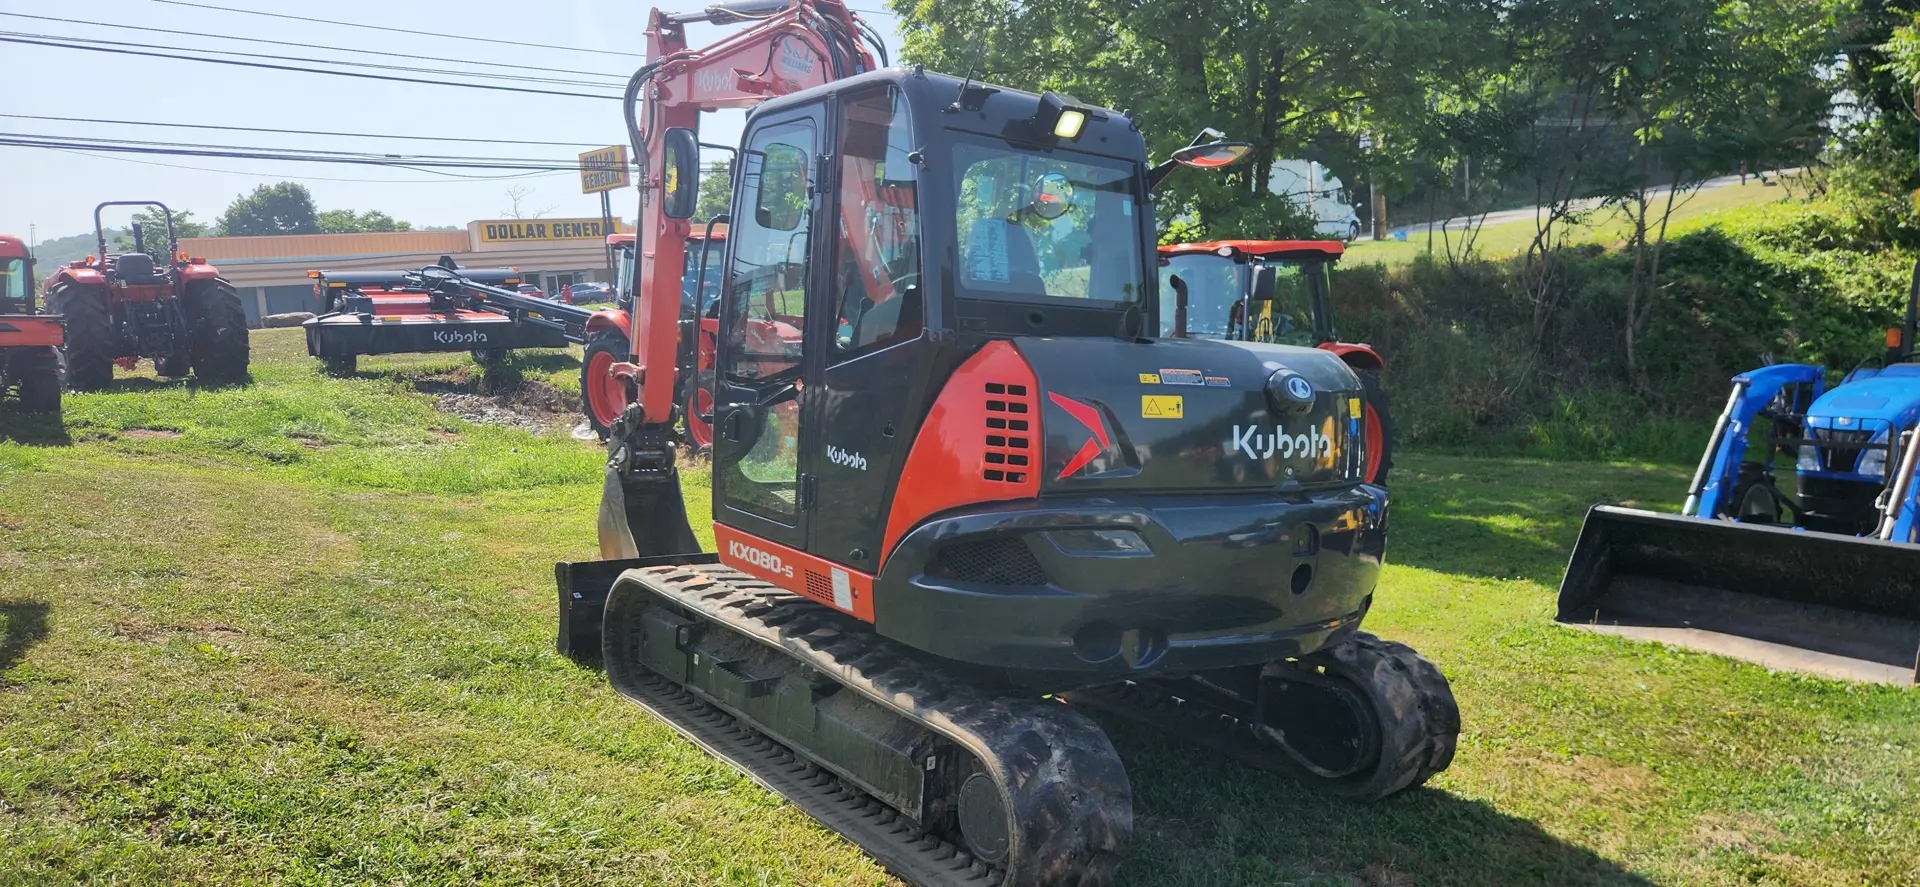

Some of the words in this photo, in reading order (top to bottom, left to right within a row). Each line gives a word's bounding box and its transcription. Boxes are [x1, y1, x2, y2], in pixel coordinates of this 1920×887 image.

[583, 151, 616, 172] DOLLAR
[583, 170, 621, 190] GENERAL
[486, 223, 547, 240] DOLLAR
[433, 329, 488, 344] Kubota
[1232, 424, 1332, 460] Kubota
[827, 444, 867, 471] Kubota
